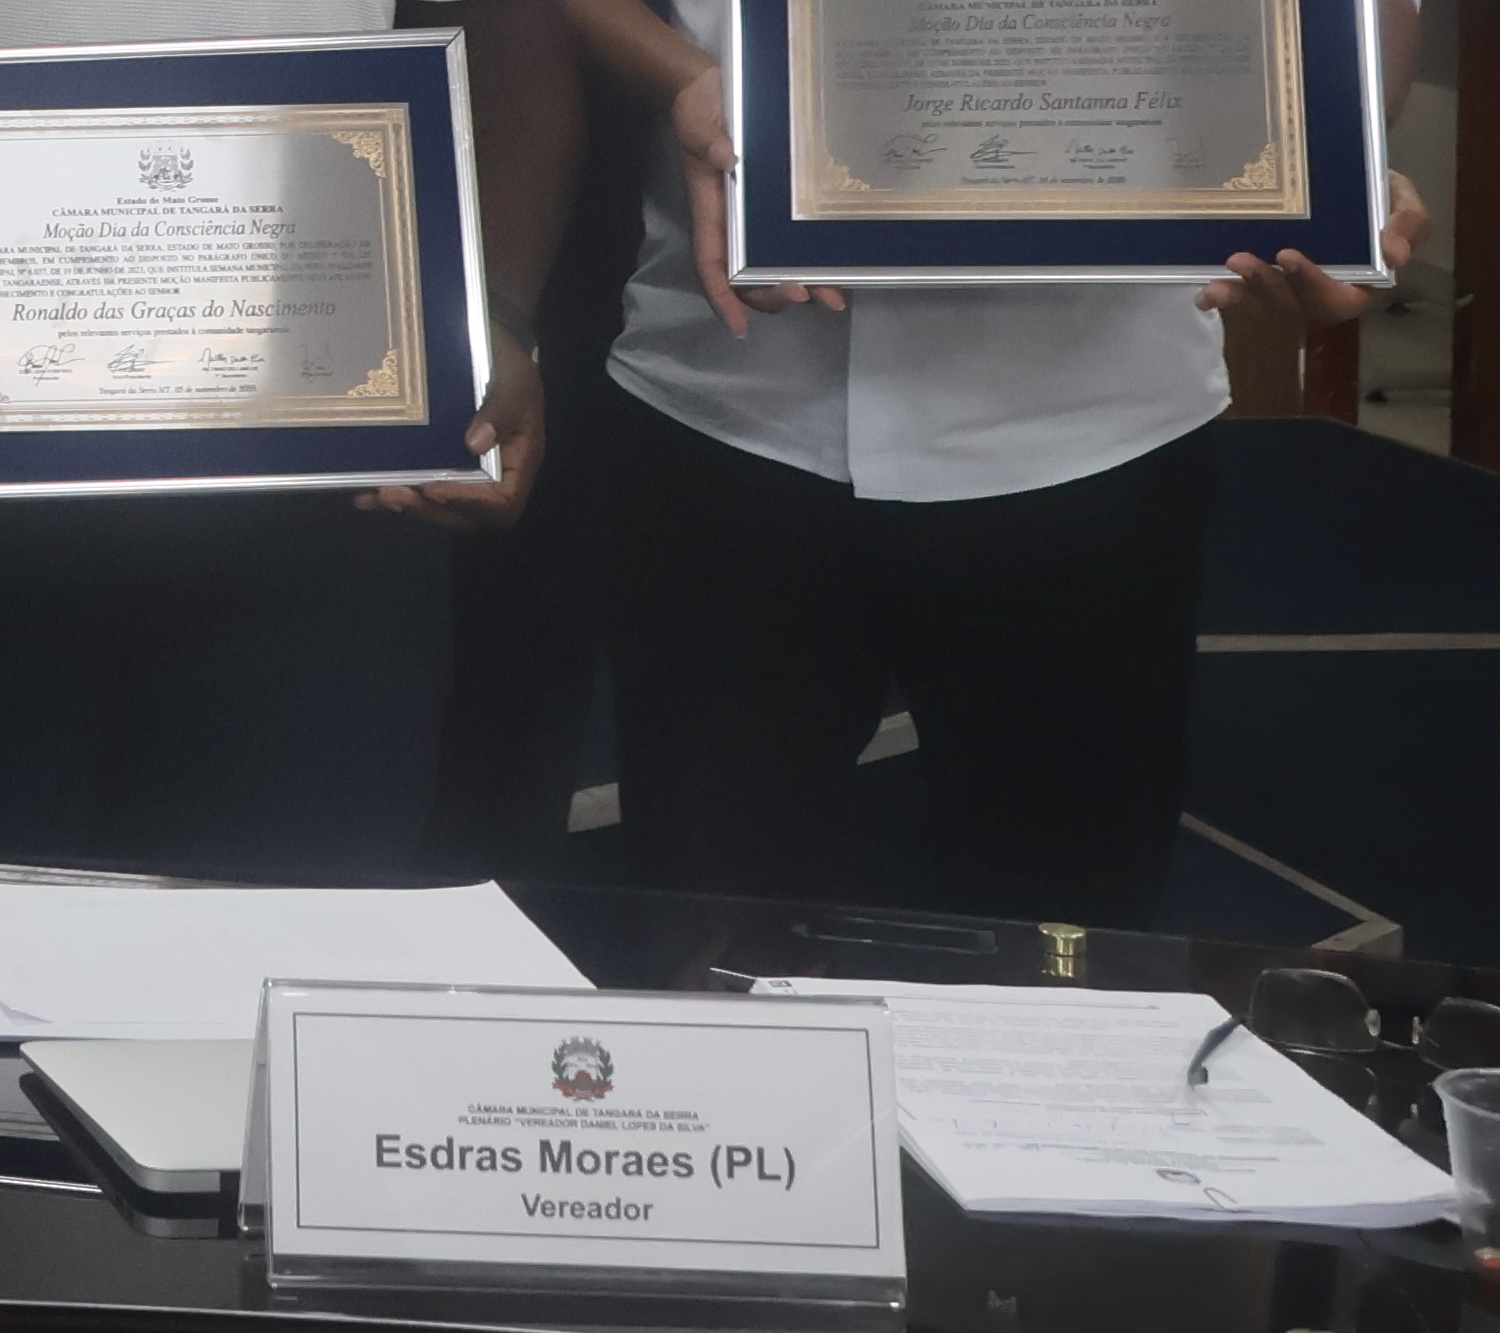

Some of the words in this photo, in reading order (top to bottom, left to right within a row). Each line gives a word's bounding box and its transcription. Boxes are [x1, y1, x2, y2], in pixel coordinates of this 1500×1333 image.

[964, 15, 994, 32] Dia
[998, 14, 1017, 31] da
[1022, 12, 1118, 31] Consciência
[1122, 11, 1171, 32] Negra
[904, 94, 954, 117] Jorge
[959, 92, 1034, 113] Ricardo
[1038, 91, 1129, 112] Santanna
[1134, 90, 1184, 111] Félix
[52, 206, 100, 217] CÂMARA
[101, 207, 160, 217] MUNICIPAL
[162, 206, 177, 215] DE
[179, 203, 230, 215] TANGARÁ
[232, 205, 248, 214] DA
[249, 205, 284, 214] SERRA
[117, 196, 147, 206] Estado
[149, 196, 160, 205] de
[162, 195, 186, 204] Mato
[43, 222, 95, 242] Moção
[98, 220, 127, 238] Dia
[130, 220, 150, 237] da
[154, 219, 246, 237] Consciência
[250, 218, 296, 239] Negra
[11, 301, 88, 322] Ronaldo
[93, 300, 125, 321] das
[130, 300, 197, 323] Graças
[202, 299, 225, 319] do
[229, 298, 336, 319] Nascimento
[467, 1103, 513, 1116] CÂMARA
[516, 1106, 573, 1118] MUNICIPAL
[575, 1107, 590, 1118] DE
[646, 1110, 661, 1120] DA
[660, 1122, 675, 1132] DA
[374, 1134, 524, 1174] Esdras
[539, 1138, 695, 1178] Moraes
[709, 1145, 797, 1192] (PL)
[520, 1193, 654, 1222] Vereador
